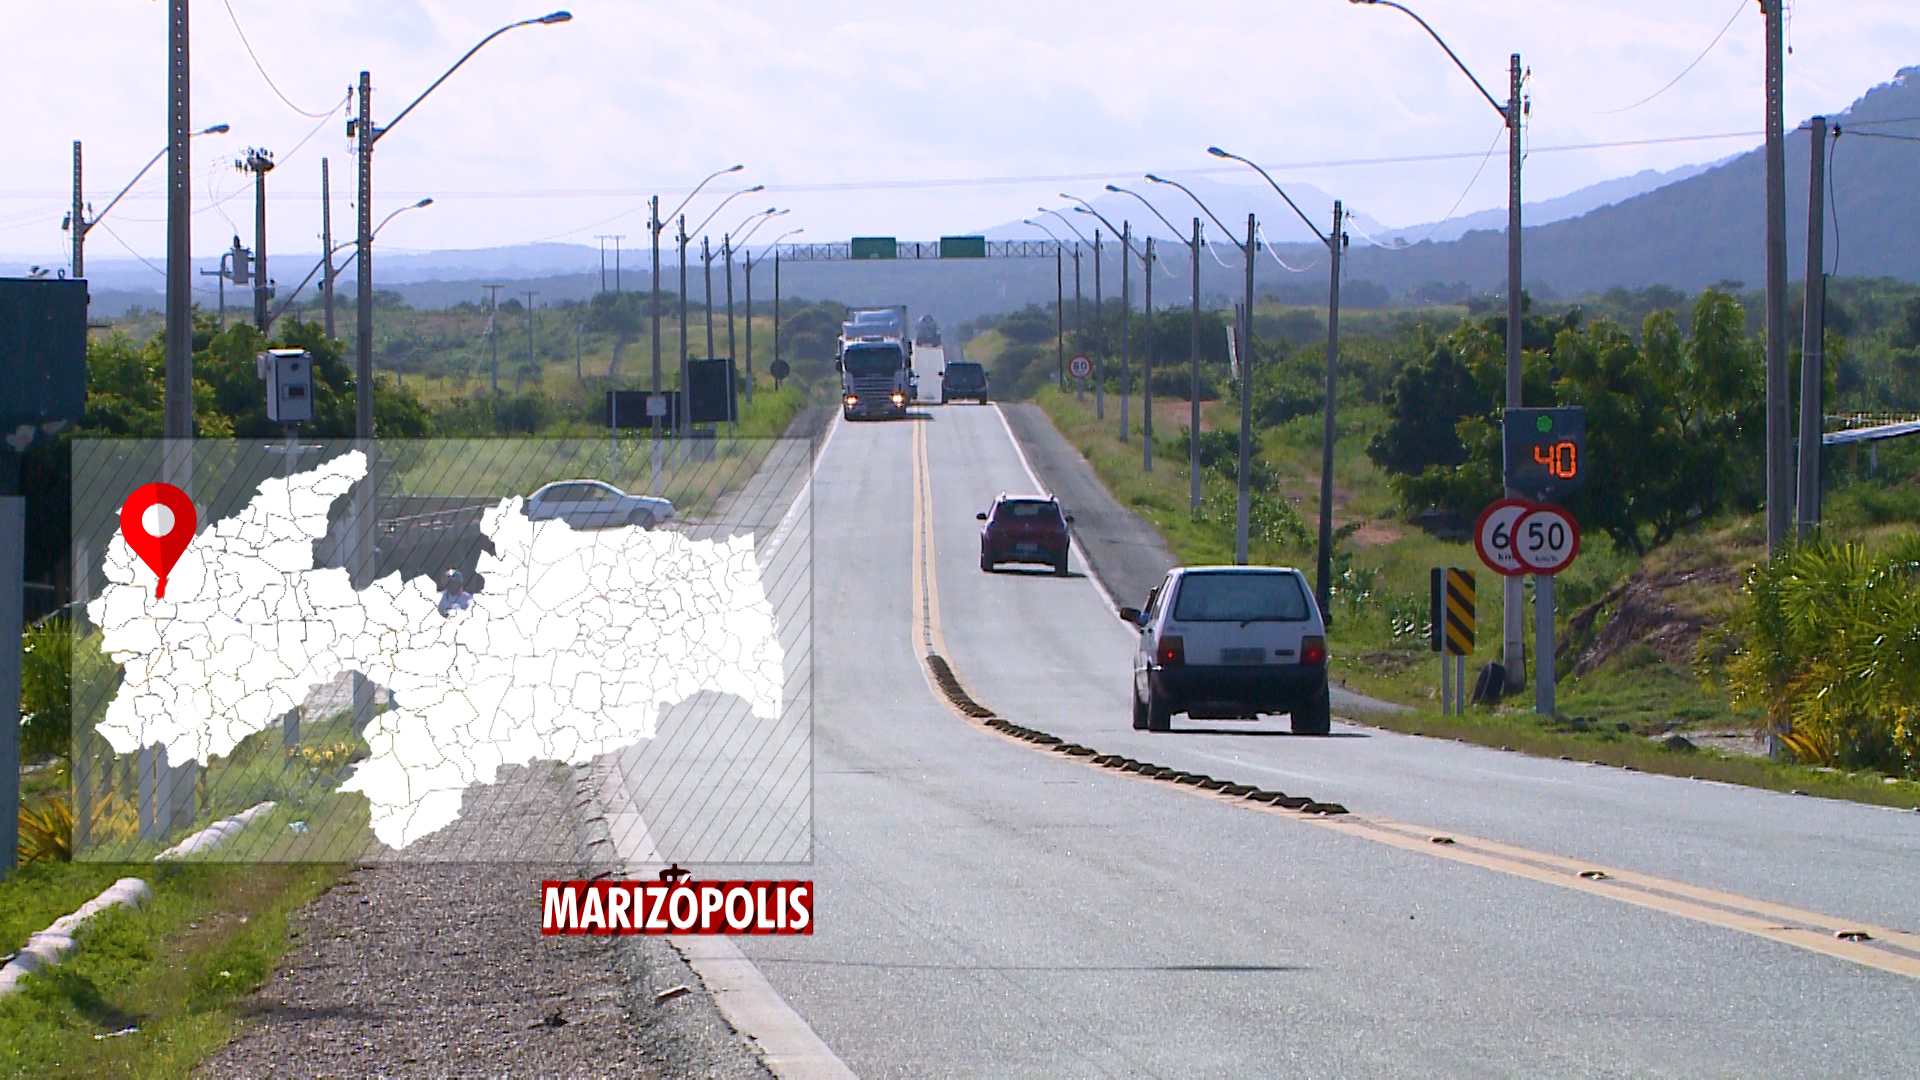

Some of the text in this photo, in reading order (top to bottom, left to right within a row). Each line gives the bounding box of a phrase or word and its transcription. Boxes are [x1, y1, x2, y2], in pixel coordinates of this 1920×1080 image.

[1533, 440, 1577, 479] 40
[1491, 521, 1510, 550] 6
[1528, 521, 1564, 551] 50
